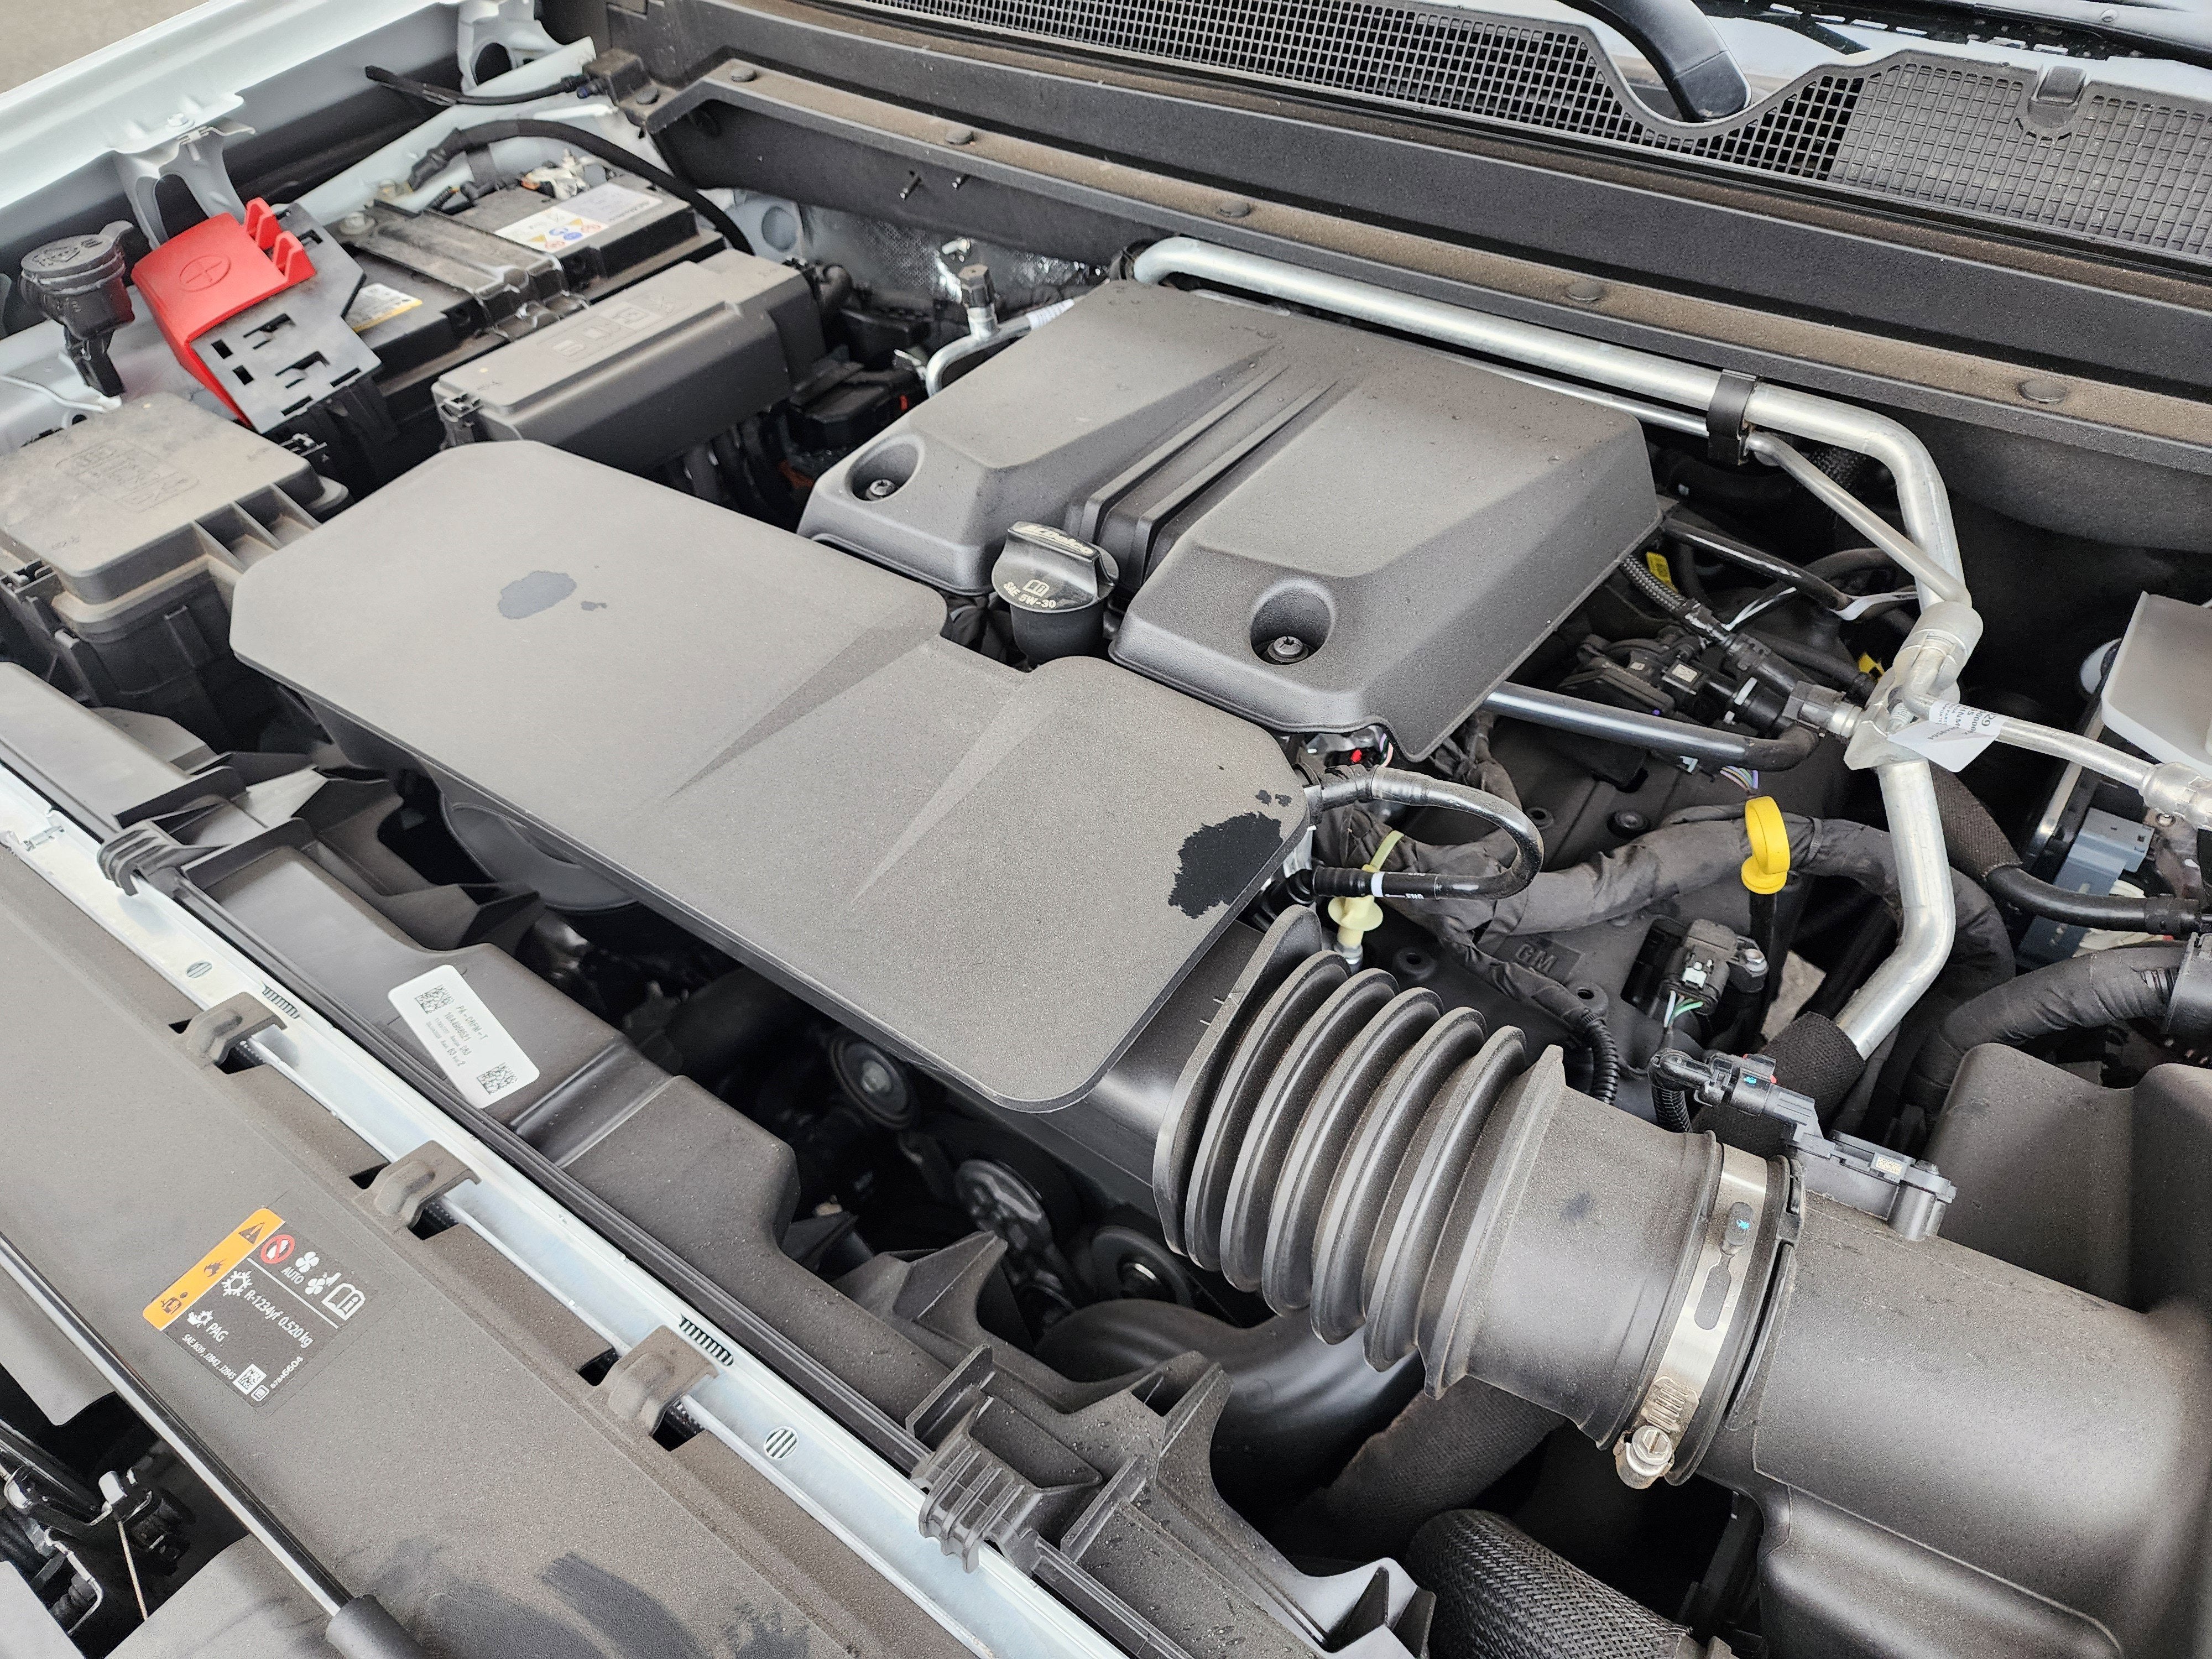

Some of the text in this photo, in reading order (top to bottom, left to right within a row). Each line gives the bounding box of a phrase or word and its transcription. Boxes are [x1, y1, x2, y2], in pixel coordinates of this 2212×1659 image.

[1023, 525, 1094, 554] ACDelco
[1003, 582, 1056, 608] SAE 5W-30
[1515, 943, 1557, 974] GM
[281, 1266, 305, 1285] AUTO
[206, 1322, 229, 1343] PAG
[244, 1289, 283, 1321] R-1234yf
[300, 1331, 314, 1349] kg
[181, 1333, 196, 1347] SAE
[218, 1364, 237, 1380] J2845
